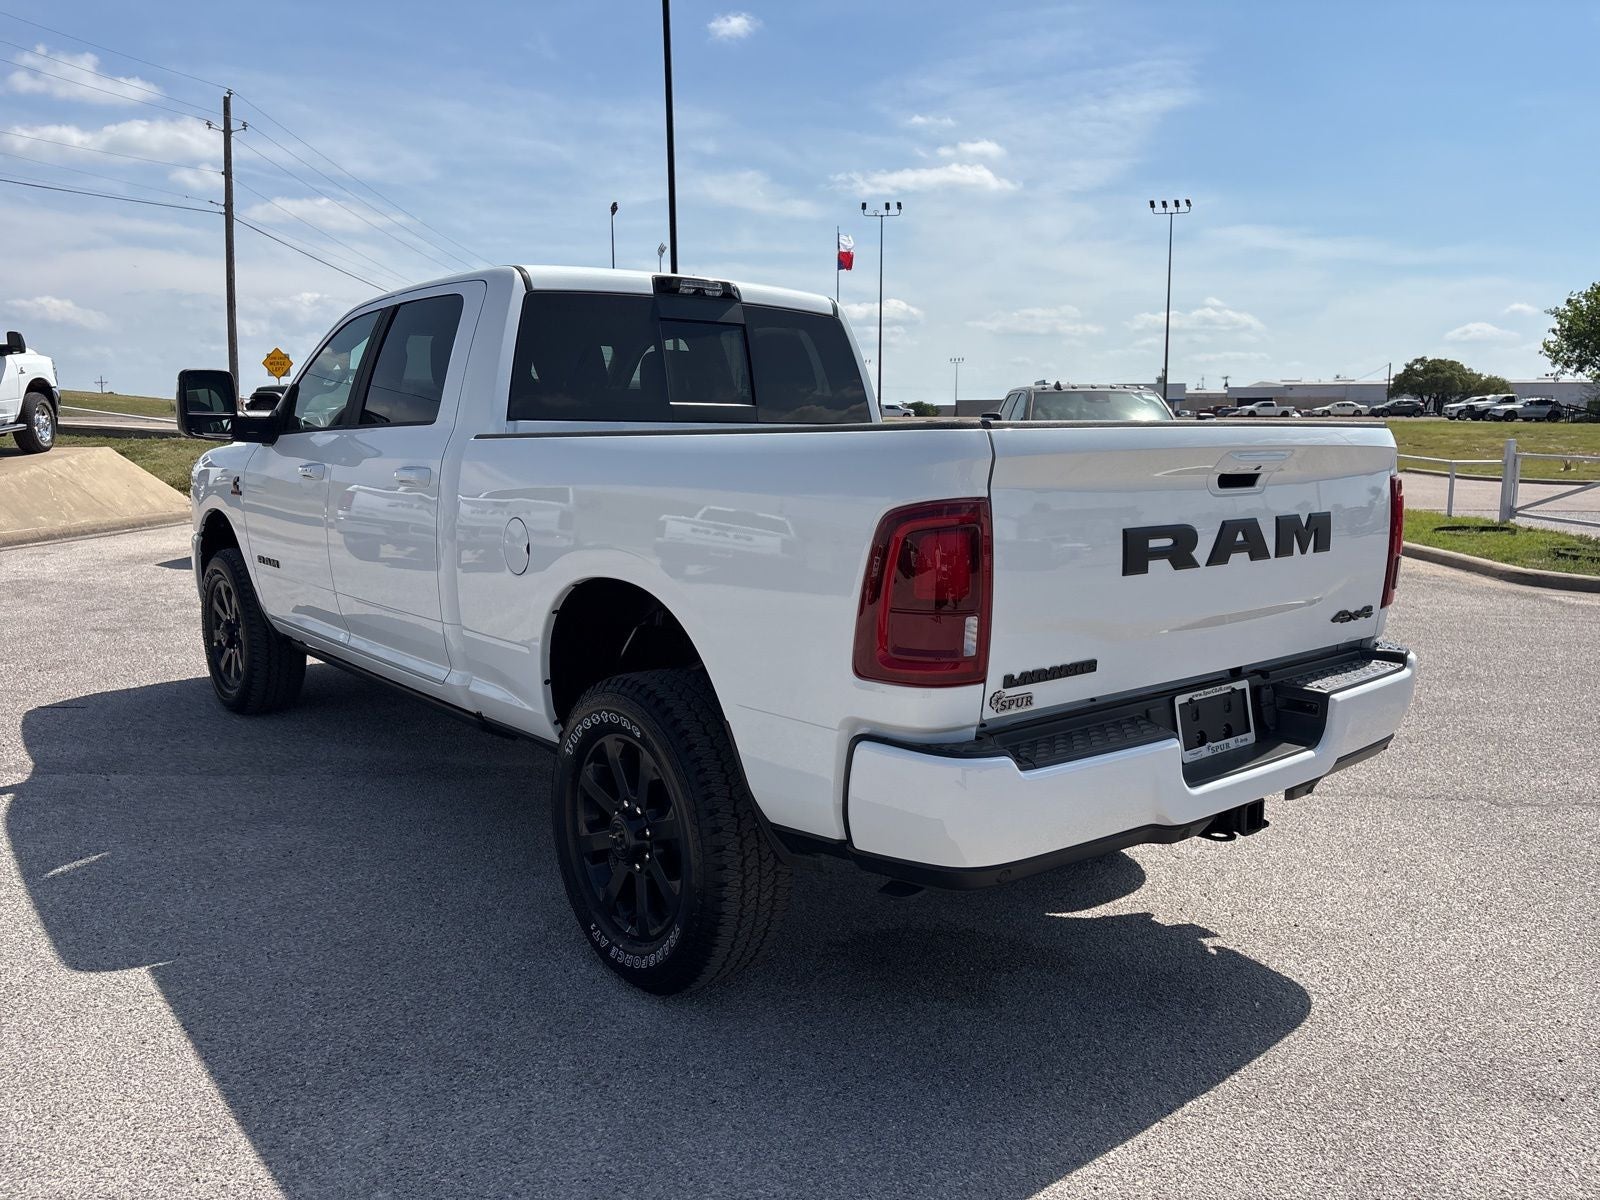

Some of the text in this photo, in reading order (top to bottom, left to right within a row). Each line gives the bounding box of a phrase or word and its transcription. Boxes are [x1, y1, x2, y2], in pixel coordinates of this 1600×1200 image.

[1122, 511, 1332, 577] RAM
[1003, 658, 1098, 689] LARAMIE
[999, 695, 1034, 712] SPUR
[564, 710, 641, 755] Firestone
[1210, 742, 1232, 754] SPUR
[609, 923, 681, 969] TRANSFORCE
